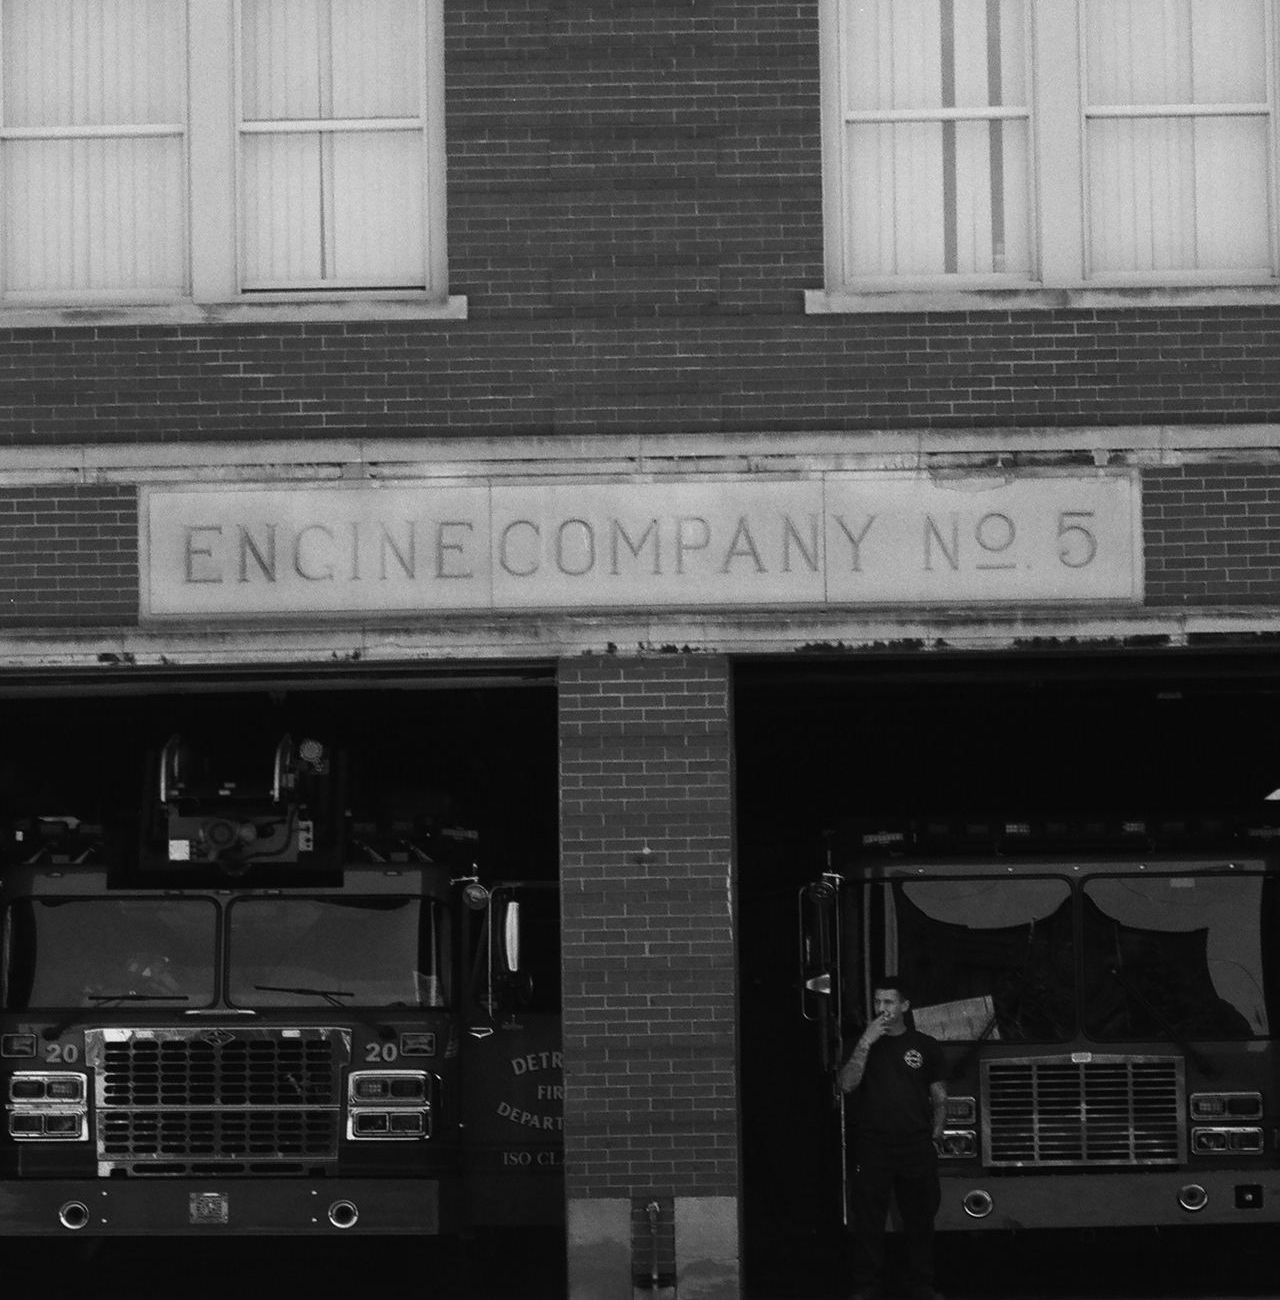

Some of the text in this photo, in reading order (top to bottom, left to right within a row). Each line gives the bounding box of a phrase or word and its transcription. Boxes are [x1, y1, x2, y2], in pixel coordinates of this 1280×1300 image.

[182, 519, 474, 584] ENGINE
[498, 513, 878, 577] COMPANY
[1057, 509, 1098, 569] 5
[46, 1043, 79, 1063] 20
[365, 1042, 398, 1062] 20
[511, 1051, 563, 1076] DETR
[537, 1085, 563, 1100] FIR
[497, 1101, 563, 1130] DEPART
[502, 1151, 532, 1166] ISO
